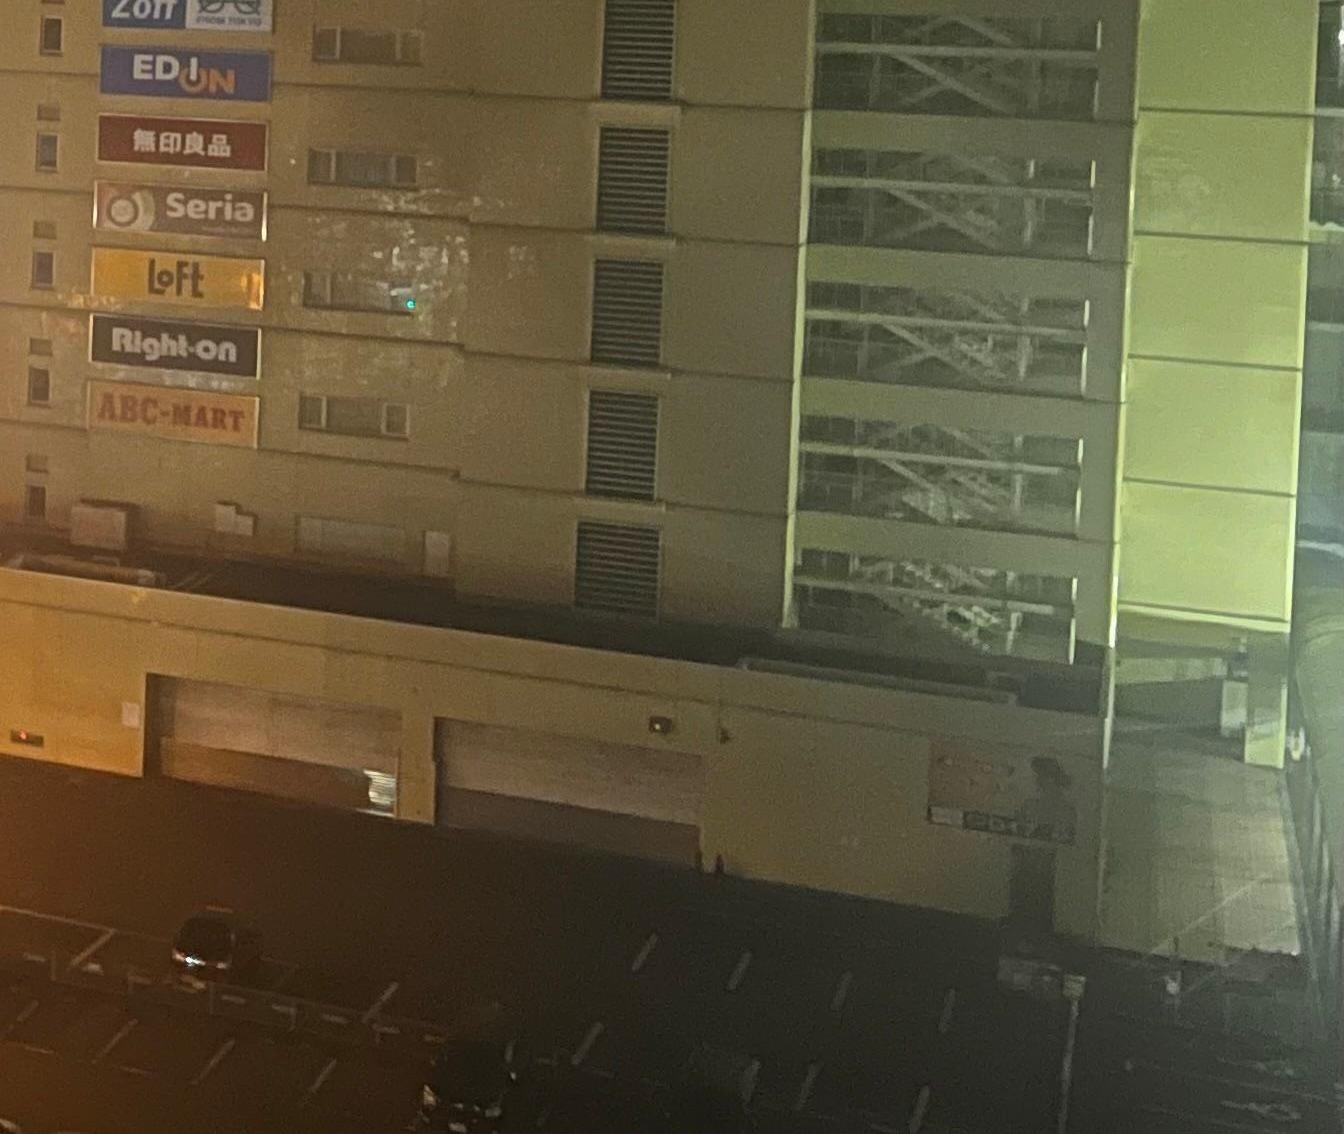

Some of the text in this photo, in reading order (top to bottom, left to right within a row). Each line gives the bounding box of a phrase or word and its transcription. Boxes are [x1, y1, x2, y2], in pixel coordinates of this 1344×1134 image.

[133, 54, 236, 95] EDION
[133, 128, 231, 158] 無印良品
[165, 191, 255, 222] Seria
[112, 327, 237, 362] Right-on
[97, 392, 245, 432] ABC-MART
